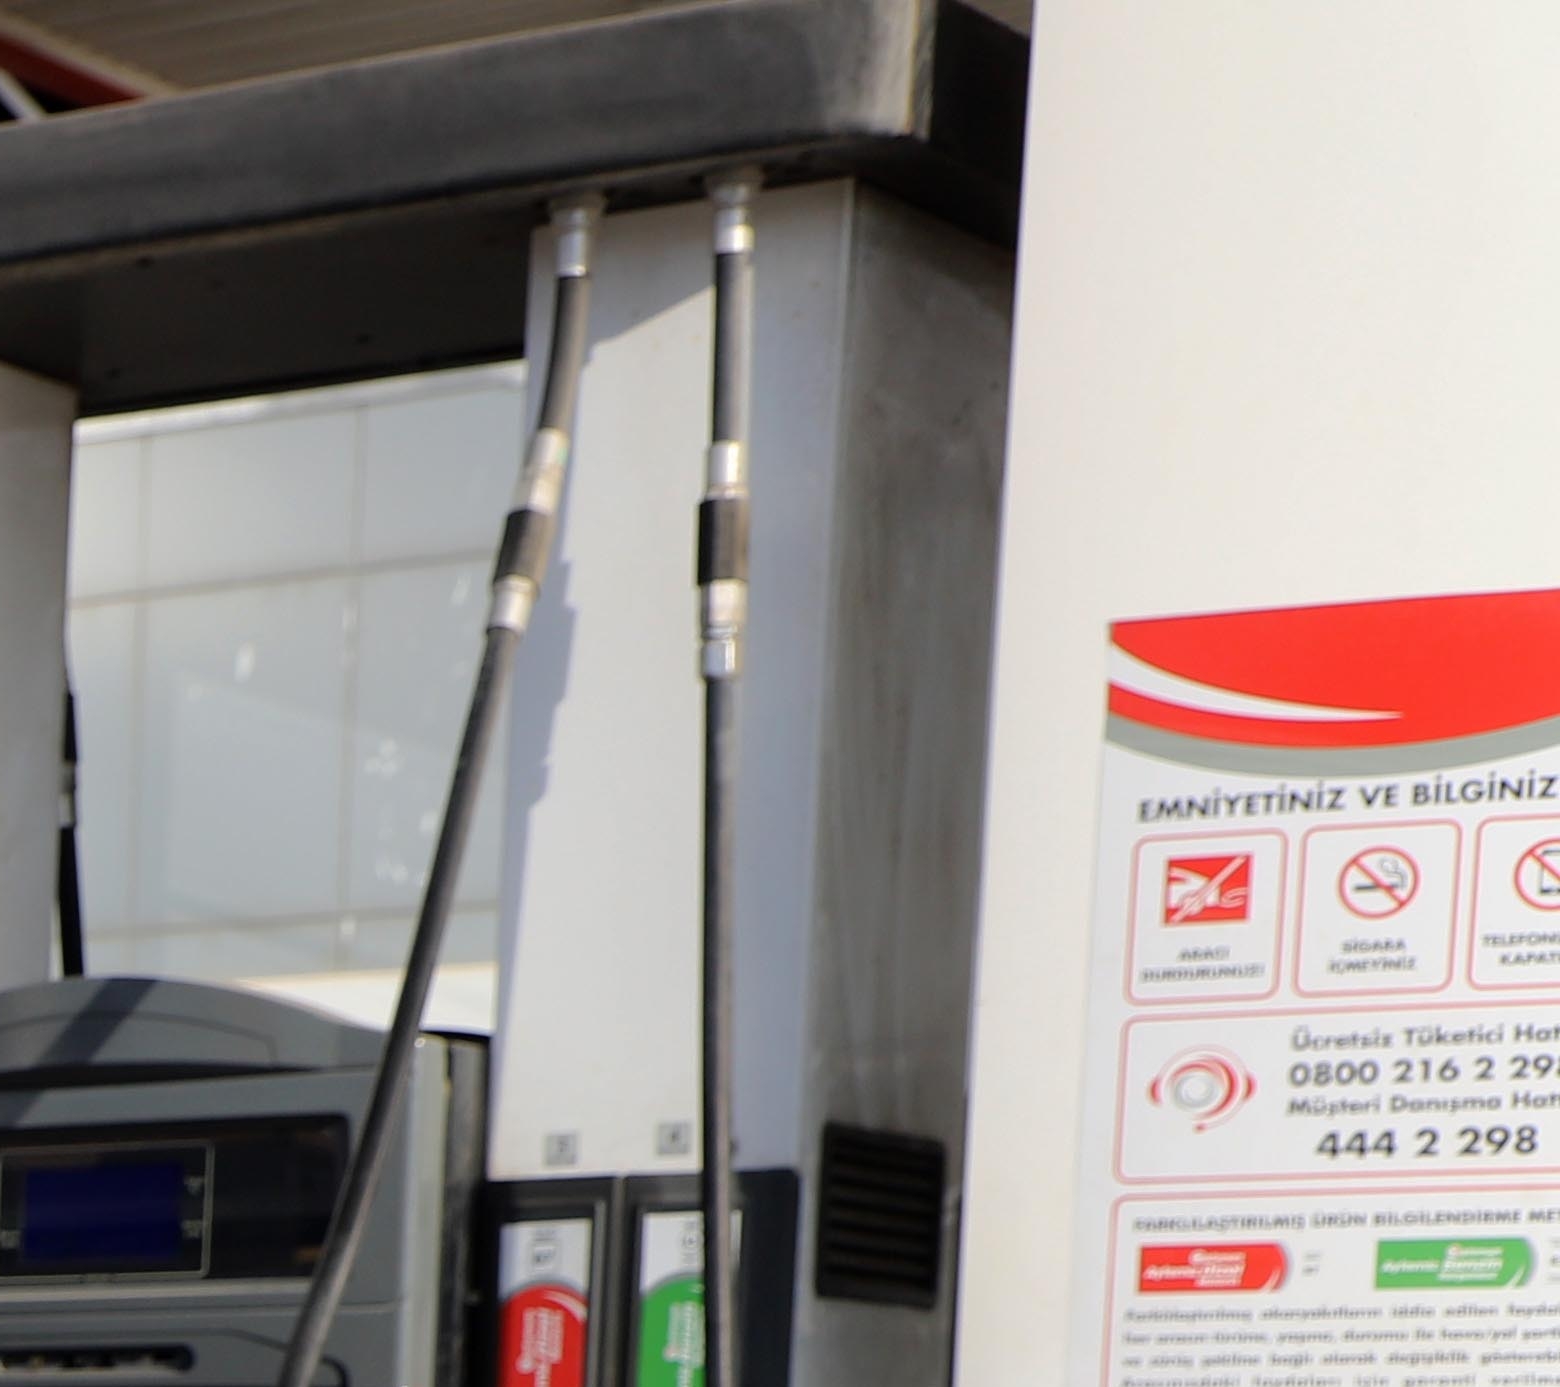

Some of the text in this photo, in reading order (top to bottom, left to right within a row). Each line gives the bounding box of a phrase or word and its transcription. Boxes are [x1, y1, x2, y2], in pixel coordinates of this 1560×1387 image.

[1138, 768, 1560, 822] EMNİYETİNİZ VE BİLGİNİZ
[1291, 1024, 1394, 1052] Ücretsiz
[1403, 1022, 1504, 1048] Tüketici
[1288, 1053, 1560, 1088] 0800 216 2 29
[1316, 1125, 1539, 1160] 444 2 298
